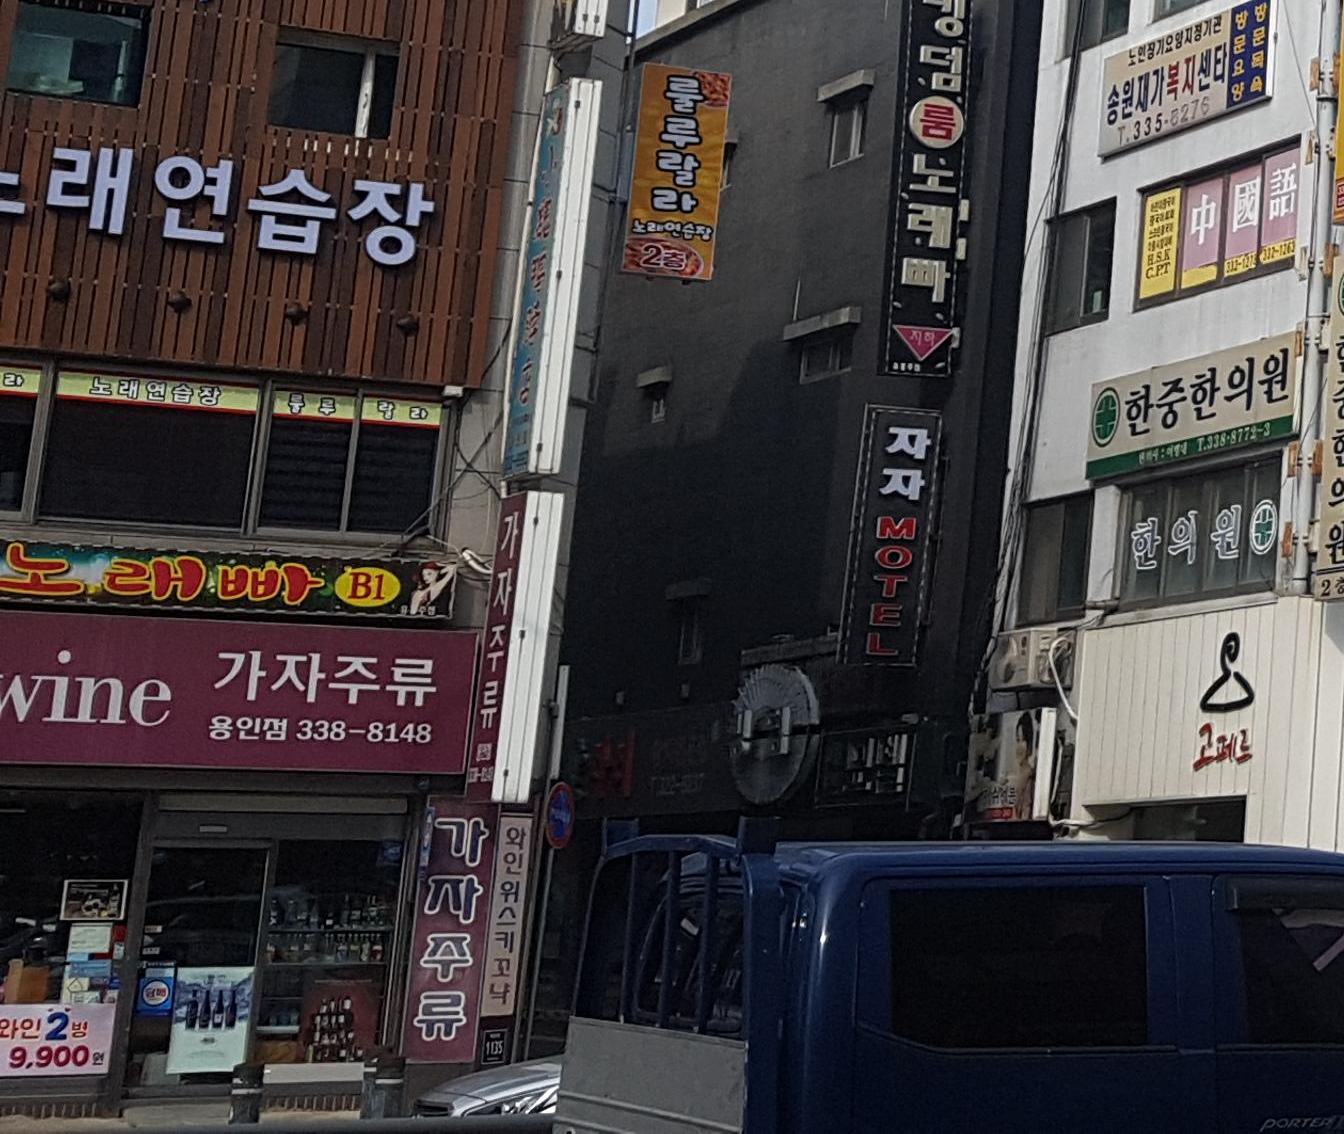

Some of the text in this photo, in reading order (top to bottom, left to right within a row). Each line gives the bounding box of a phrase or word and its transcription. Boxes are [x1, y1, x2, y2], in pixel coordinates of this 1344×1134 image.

[1128, 15, 1222, 68] 노인장기요양지정기관
[1232, 9, 1250, 103] 방문요양
[1106, 41, 1228, 126] 송원재가복지센터
[651, 75, 706, 213] 룰루랄라
[632, 220, 713, 242] 노래연습장
[1190, 162, 1297, 246] 中國語
[641, 244, 688, 270] 2층
[89, 377, 221, 406] 노래연습장
[1125, 348, 1290, 437] 한중한의원
[879, 426, 932, 502] 자자
[1131, 505, 1242, 570] 한의원
[0, 542, 388, 604] 노래빠 B1
[866, 516, 916, 656] MOTEL
[481, 511, 519, 729] 가자주류
[213, 650, 438, 707] 가자주류
[208, 715, 433, 745] 용인점 338-8148
[1194, 723, 1254, 771] 고페르
[414, 817, 490, 1041] 가자주류
[0, 1012, 88, 1041] 와인 2병
[9, 1045, 105, 1068] 9,900원
[1260, 1117, 1332, 1132] PORTER
